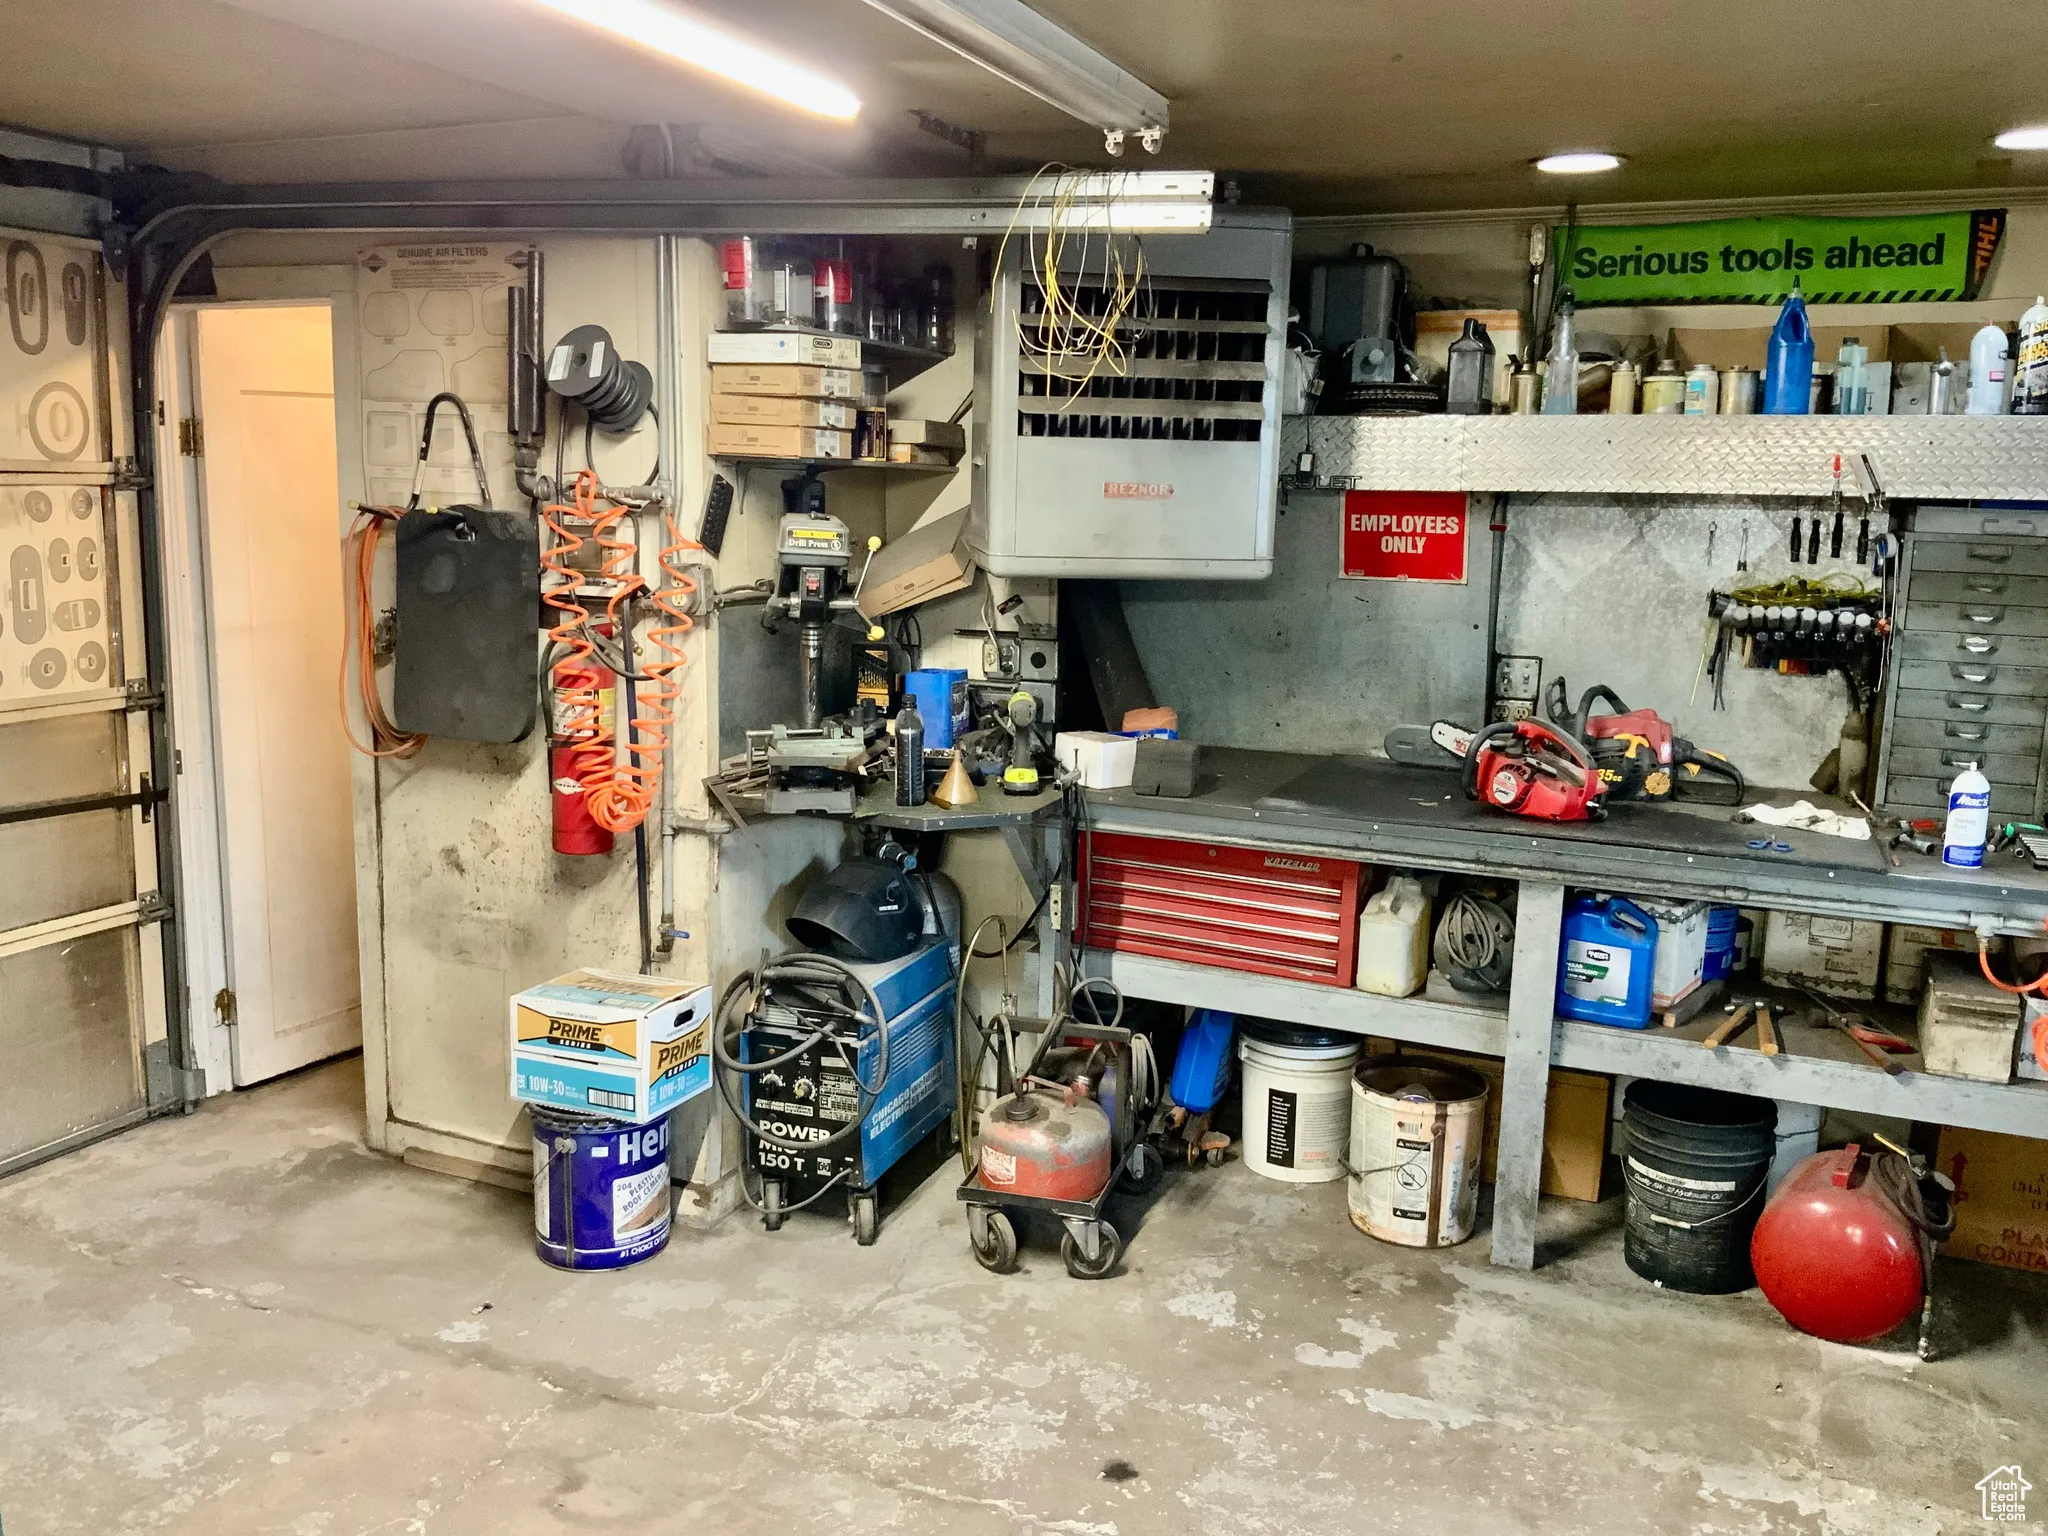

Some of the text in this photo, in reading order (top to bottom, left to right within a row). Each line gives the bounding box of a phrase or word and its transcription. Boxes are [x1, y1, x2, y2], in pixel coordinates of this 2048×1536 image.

[397, 247, 488, 258] GENUINE AIR FILTERS
[1573, 232, 1946, 280] Serious tools ahead
[1974, 217, 1998, 283] TIHL
[1108, 483, 1169, 496] REZNOR
[1351, 514, 1460, 534] EMPLOYEES
[789, 538, 828, 549] Drill Press
[1381, 536, 1427, 554] ONLY
[1956, 794, 1989, 806] Mac's
[1262, 856, 1320, 872] WATERLOO
[548, 1018, 602, 1041] PRIME
[559, 1039, 591, 1049] SERIES
[657, 1031, 704, 1070] PRIME
[667, 1056, 698, 1078] SERIES
[529, 1075, 565, 1096] 10W-30
[660, 1075, 686, 1102] 10W-30
[872, 1088, 910, 1126] CHICAGO
[759, 1120, 831, 1142] POWER
[870, 1100, 910, 1140] ELECTRIC
[619, 1124, 668, 1165] Hen
[759, 1151, 805, 1171] 150 T
[617, 1182, 632, 1191] 204
[623, 1169, 665, 1212] ROOF CEMENT
[629, 1171, 655, 1197] PLASTIC
[1674, 1188, 1710, 1200] Hydraulic
[631, 1241, 654, 1255] CHOICE
[2001, 1227, 2048, 1249] PLA
[1976, 1243, 2048, 1267] CONTA
